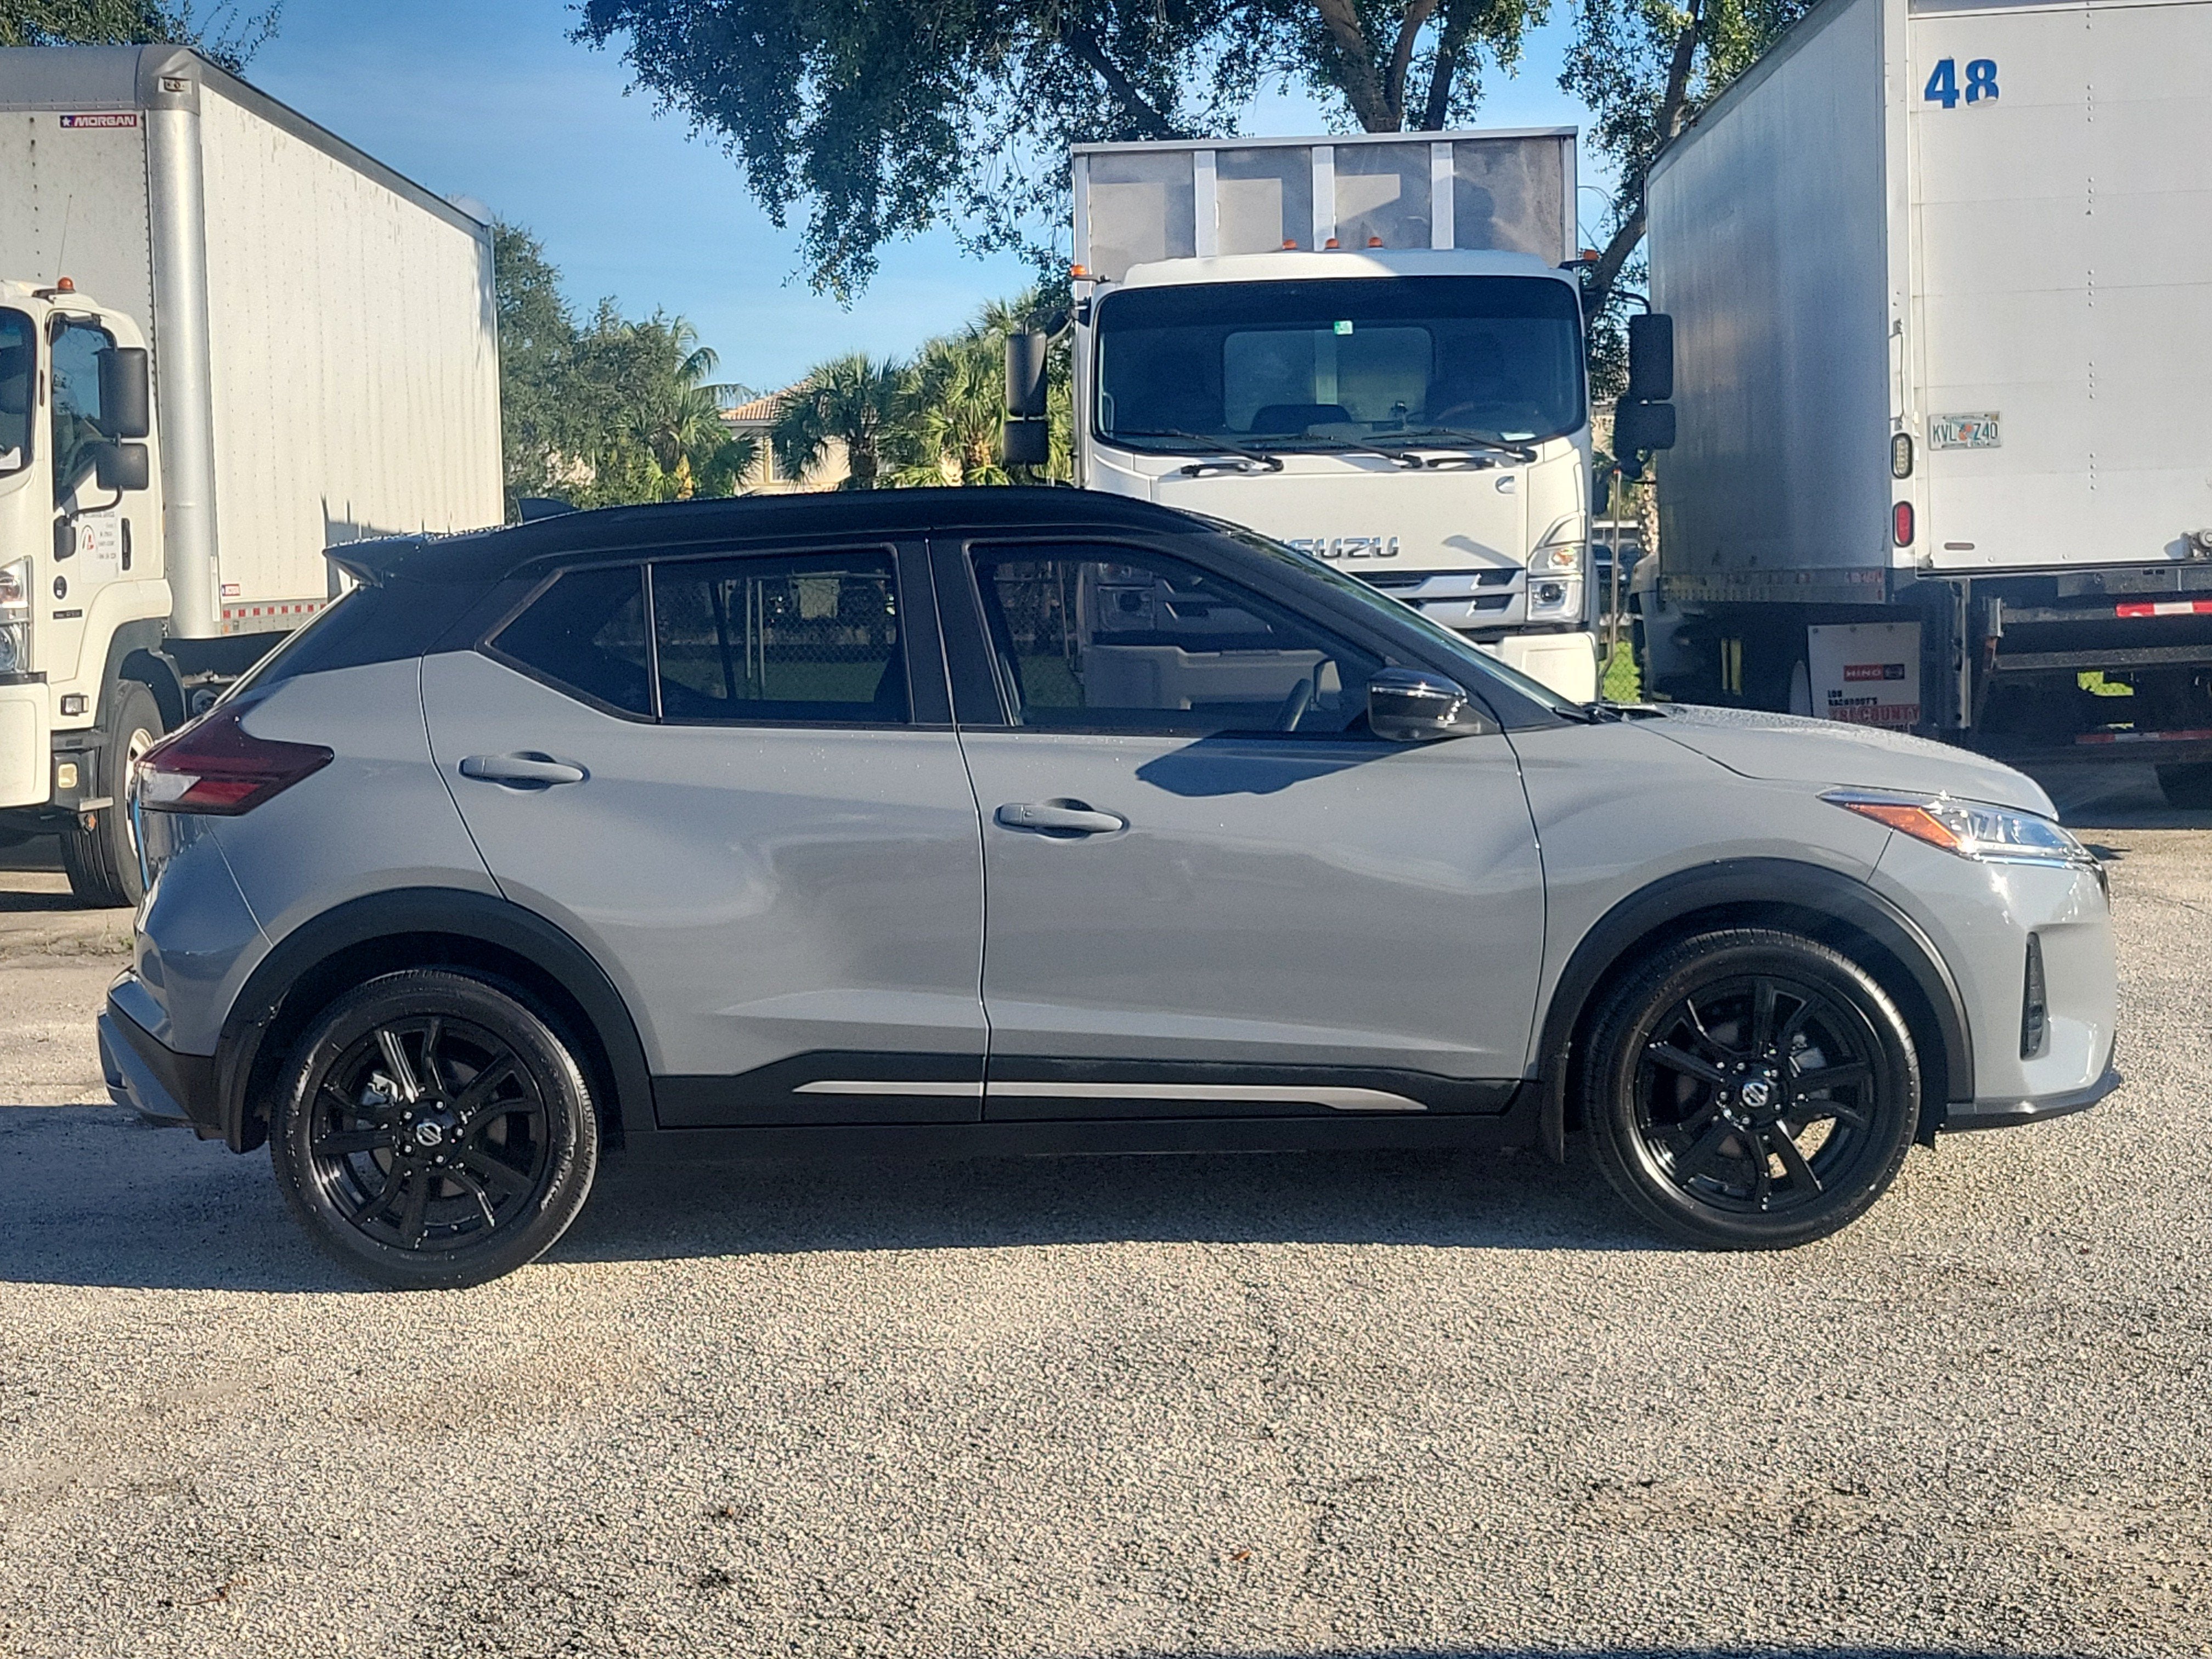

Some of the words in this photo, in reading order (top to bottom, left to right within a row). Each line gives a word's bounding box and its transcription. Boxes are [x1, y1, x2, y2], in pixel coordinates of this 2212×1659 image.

[1924, 58, 1999, 108] 48
[74, 116, 135, 127] MORGAN
[1932, 422, 1957, 442] KVL
[1973, 421, 1999, 441] Z40
[1279, 537, 1399, 558] SUZU
[1846, 668, 1881, 678] HINO
